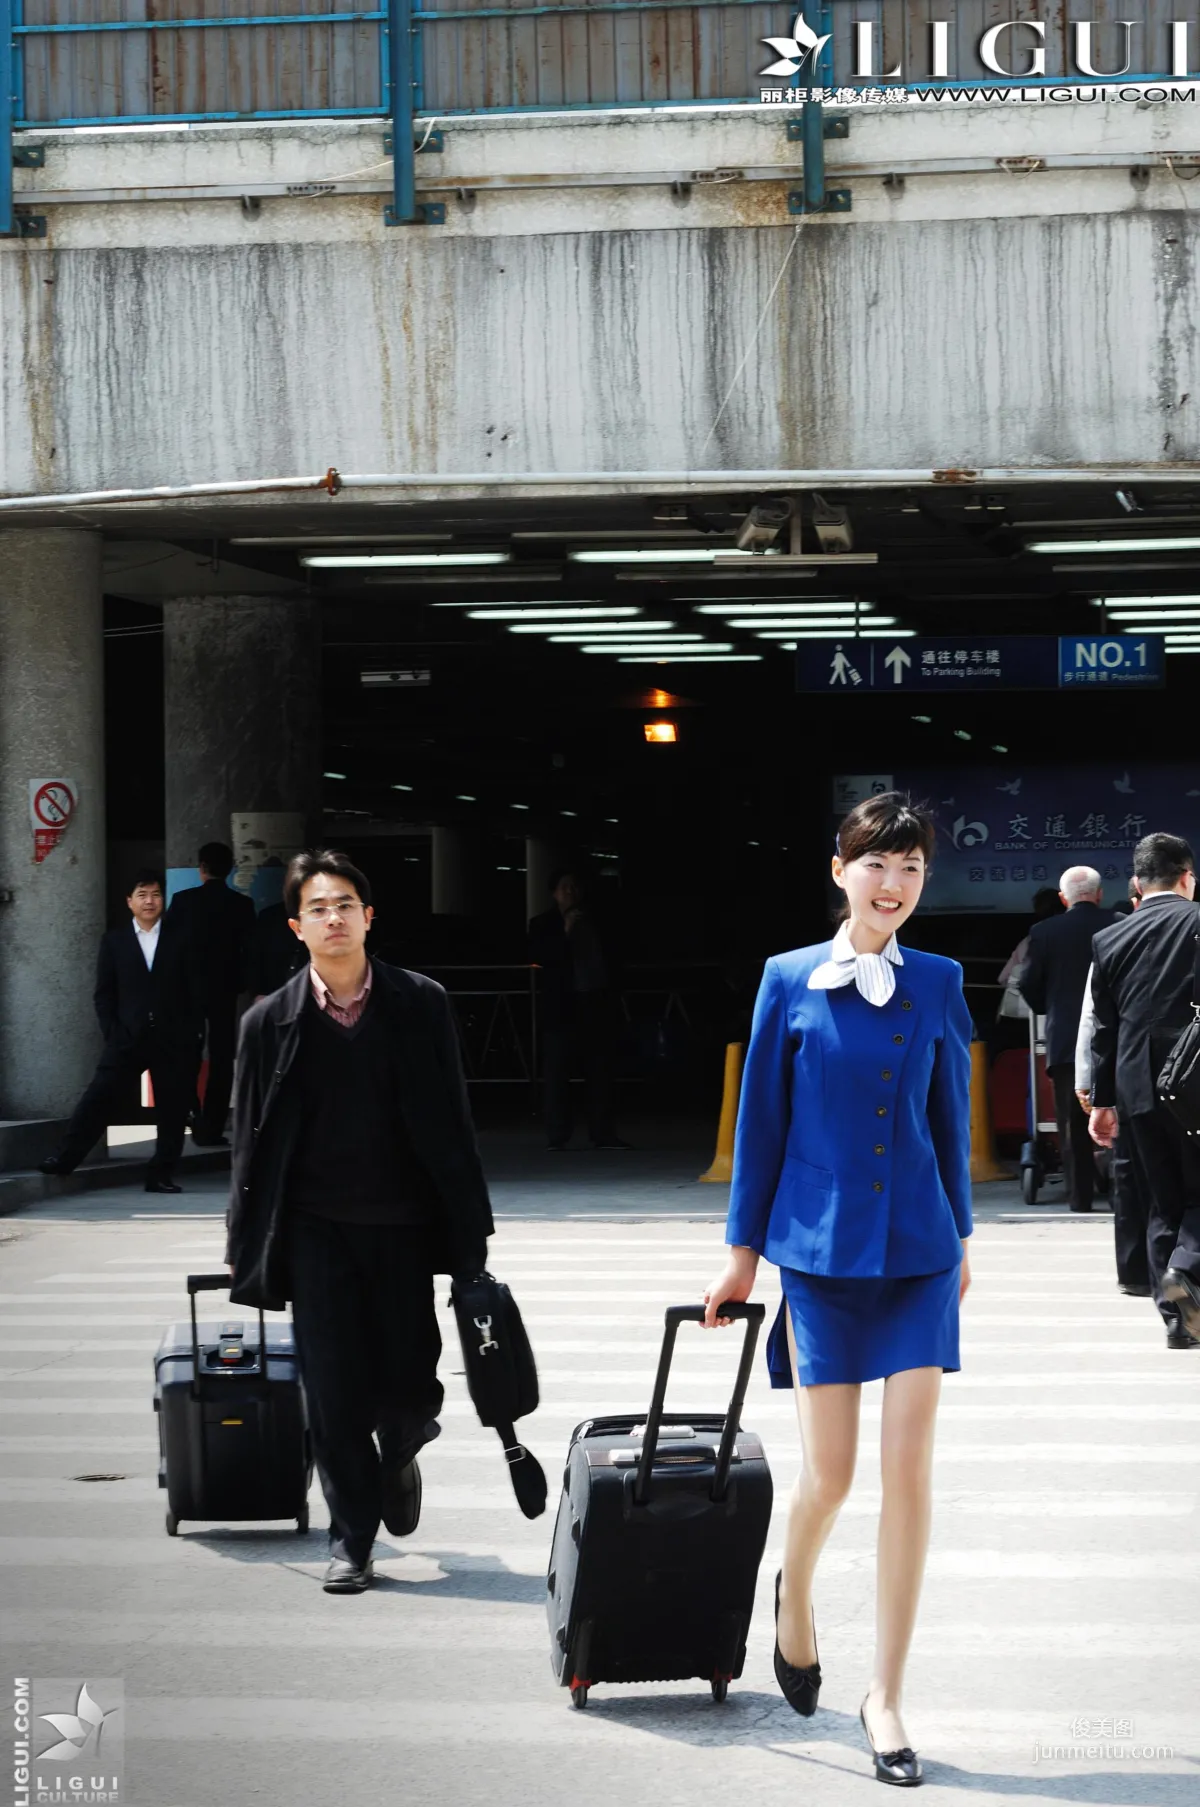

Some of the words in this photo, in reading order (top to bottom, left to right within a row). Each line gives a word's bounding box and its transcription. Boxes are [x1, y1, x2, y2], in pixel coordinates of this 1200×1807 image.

[921, 649, 1000, 664] 通往停车楼
[1075, 642, 1147, 668] NO.1
[921, 667, 932, 676] To
[933, 667, 965, 678] Parking
[966, 666, 1001, 677] Building
[1008, 812, 1147, 840] 交通銀行
[994, 841, 1027, 850] BANK
[1033, 841, 1049, 850] OF
